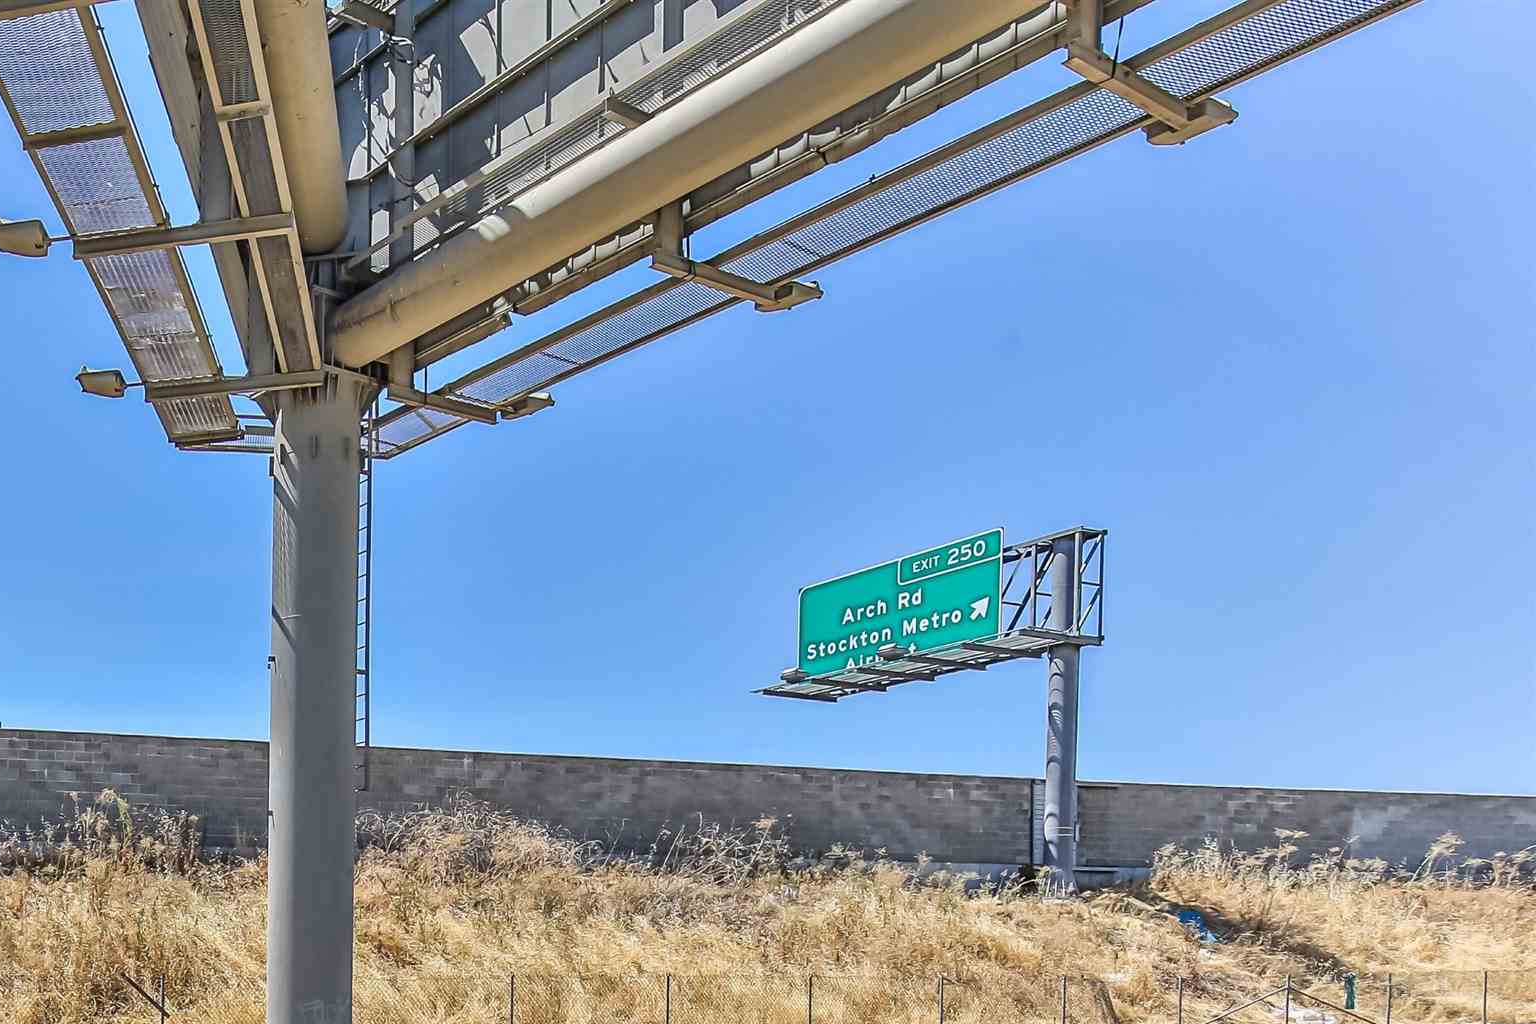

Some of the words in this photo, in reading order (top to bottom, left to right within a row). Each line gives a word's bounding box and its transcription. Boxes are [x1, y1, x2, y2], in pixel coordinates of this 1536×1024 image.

[912, 555, 941, 573] EXIT
[947, 540, 986, 565] 250
[842, 600, 887, 625] Arch
[897, 588, 923, 610] Rd
[807, 627, 892, 660] Stockton
[902, 609, 962, 637] Metro
